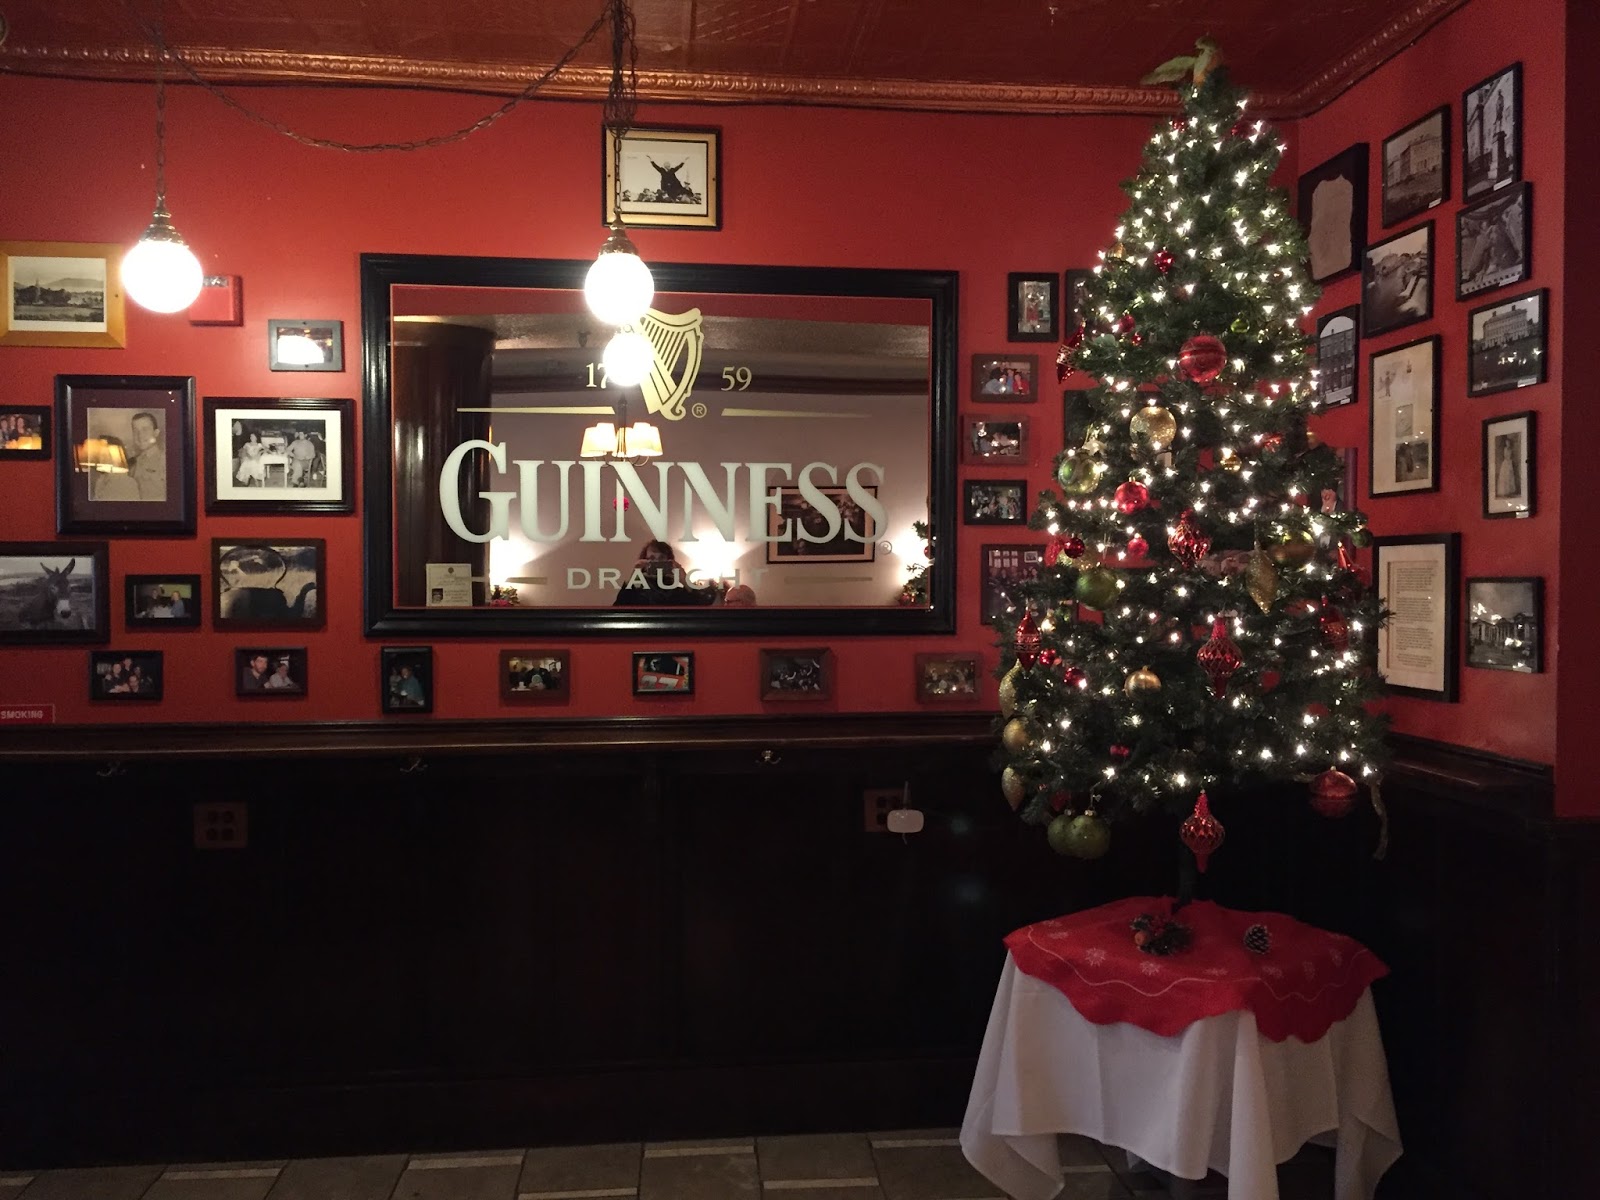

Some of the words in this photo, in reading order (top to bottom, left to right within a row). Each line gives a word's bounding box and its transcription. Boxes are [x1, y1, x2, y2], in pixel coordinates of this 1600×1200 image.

[720, 366, 752, 391] 59
[439, 439, 889, 544] GUINNESS
[567, 567, 769, 590] DRAUGHT
[0, 709, 43, 719] SMOKING
